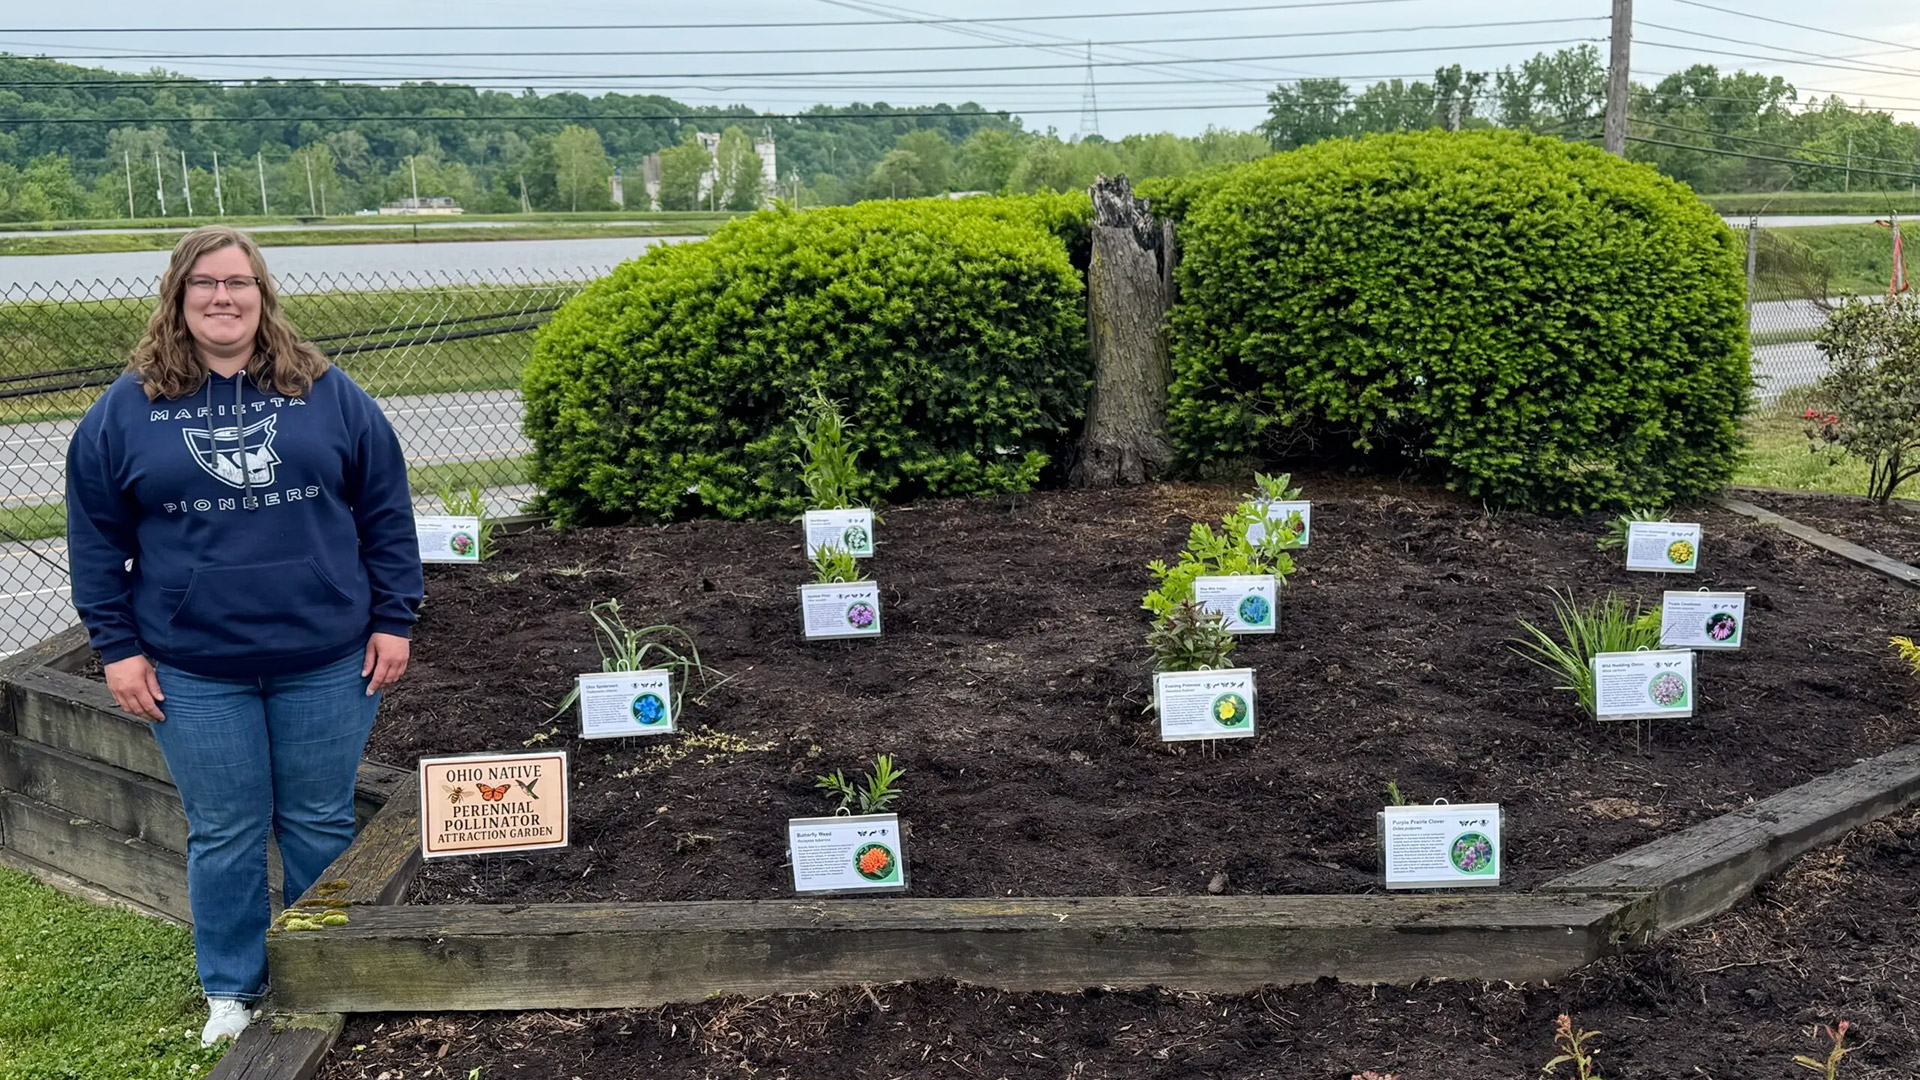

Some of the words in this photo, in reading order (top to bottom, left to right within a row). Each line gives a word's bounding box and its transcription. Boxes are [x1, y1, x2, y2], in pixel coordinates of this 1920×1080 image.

[151, 397, 306, 422] MARIETTA
[163, 485, 320, 513] PIONEERS
[446, 768, 483, 783] OHIO
[488, 765, 542, 780] NATIVE
[453, 801, 535, 818] PERENNIAL
[444, 814, 541, 832] POLLINATOR
[437, 829, 507, 844] ATTRACTION
[509, 826, 553, 839] GARDEN
